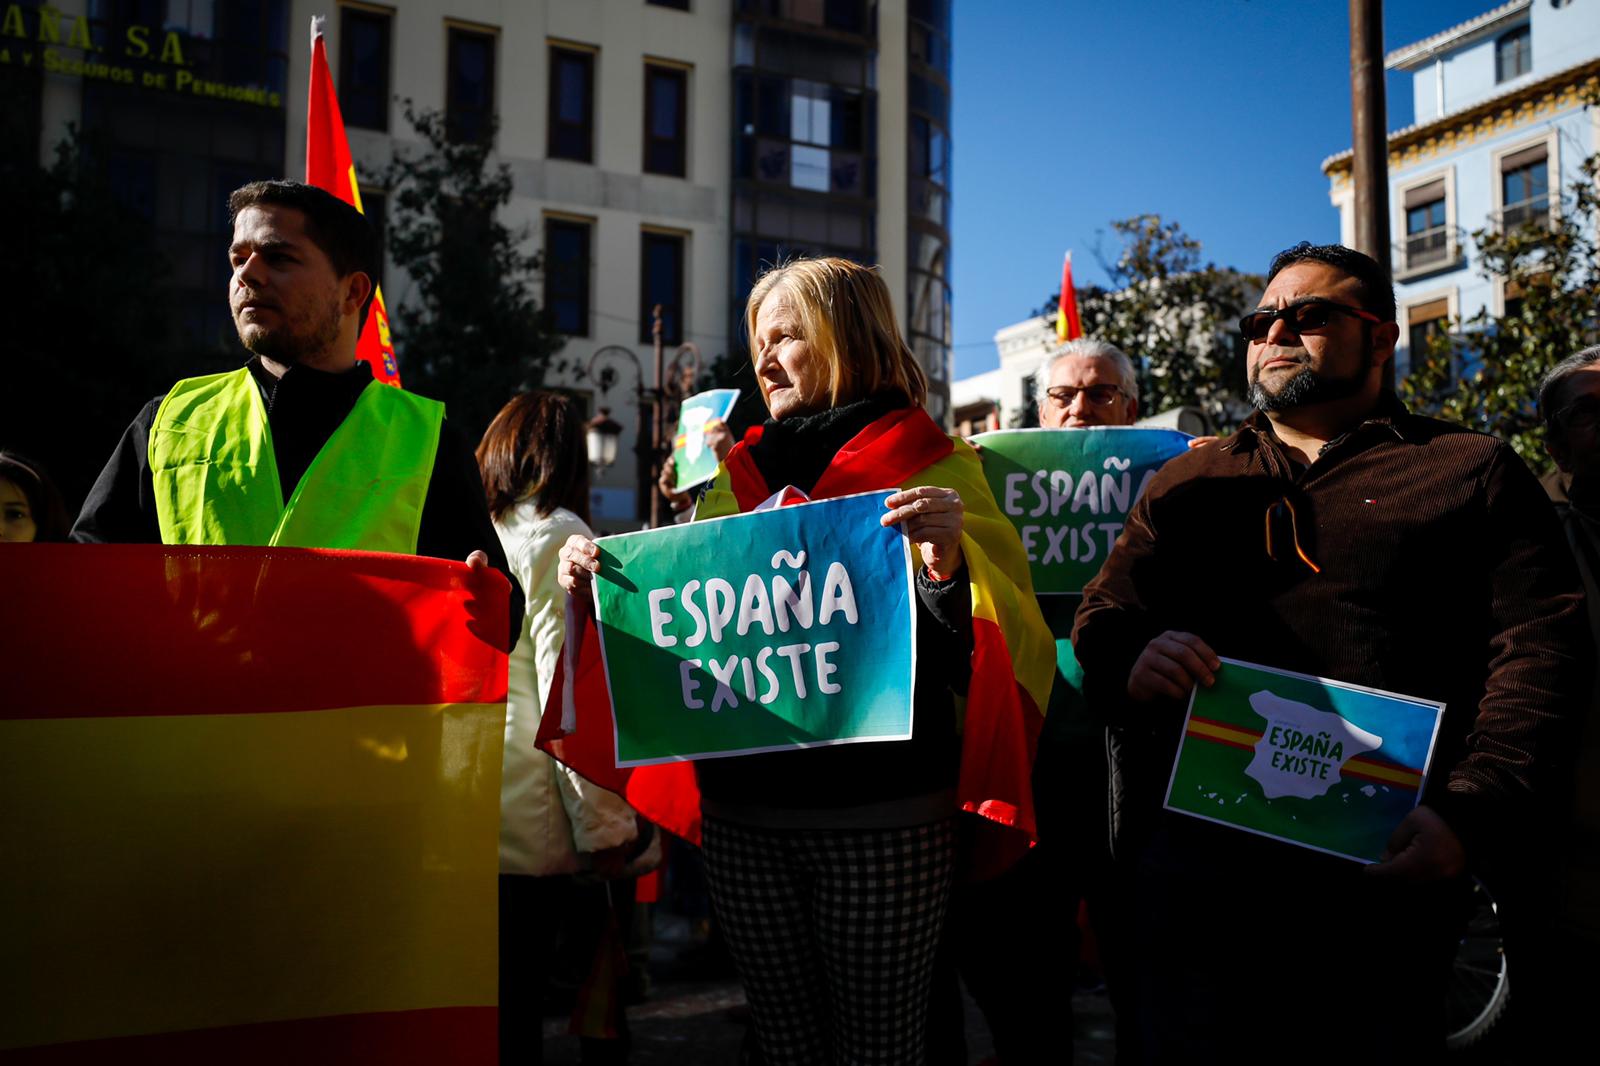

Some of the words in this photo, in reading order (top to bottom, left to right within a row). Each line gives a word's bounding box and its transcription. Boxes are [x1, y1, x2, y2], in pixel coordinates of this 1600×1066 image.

[648, 549, 859, 648] ESPAÑA
[679, 641, 842, 713] EXISTE
[1268, 726, 1344, 762] ESPAÑA
[1271, 751, 1332, 780] EXISTE
